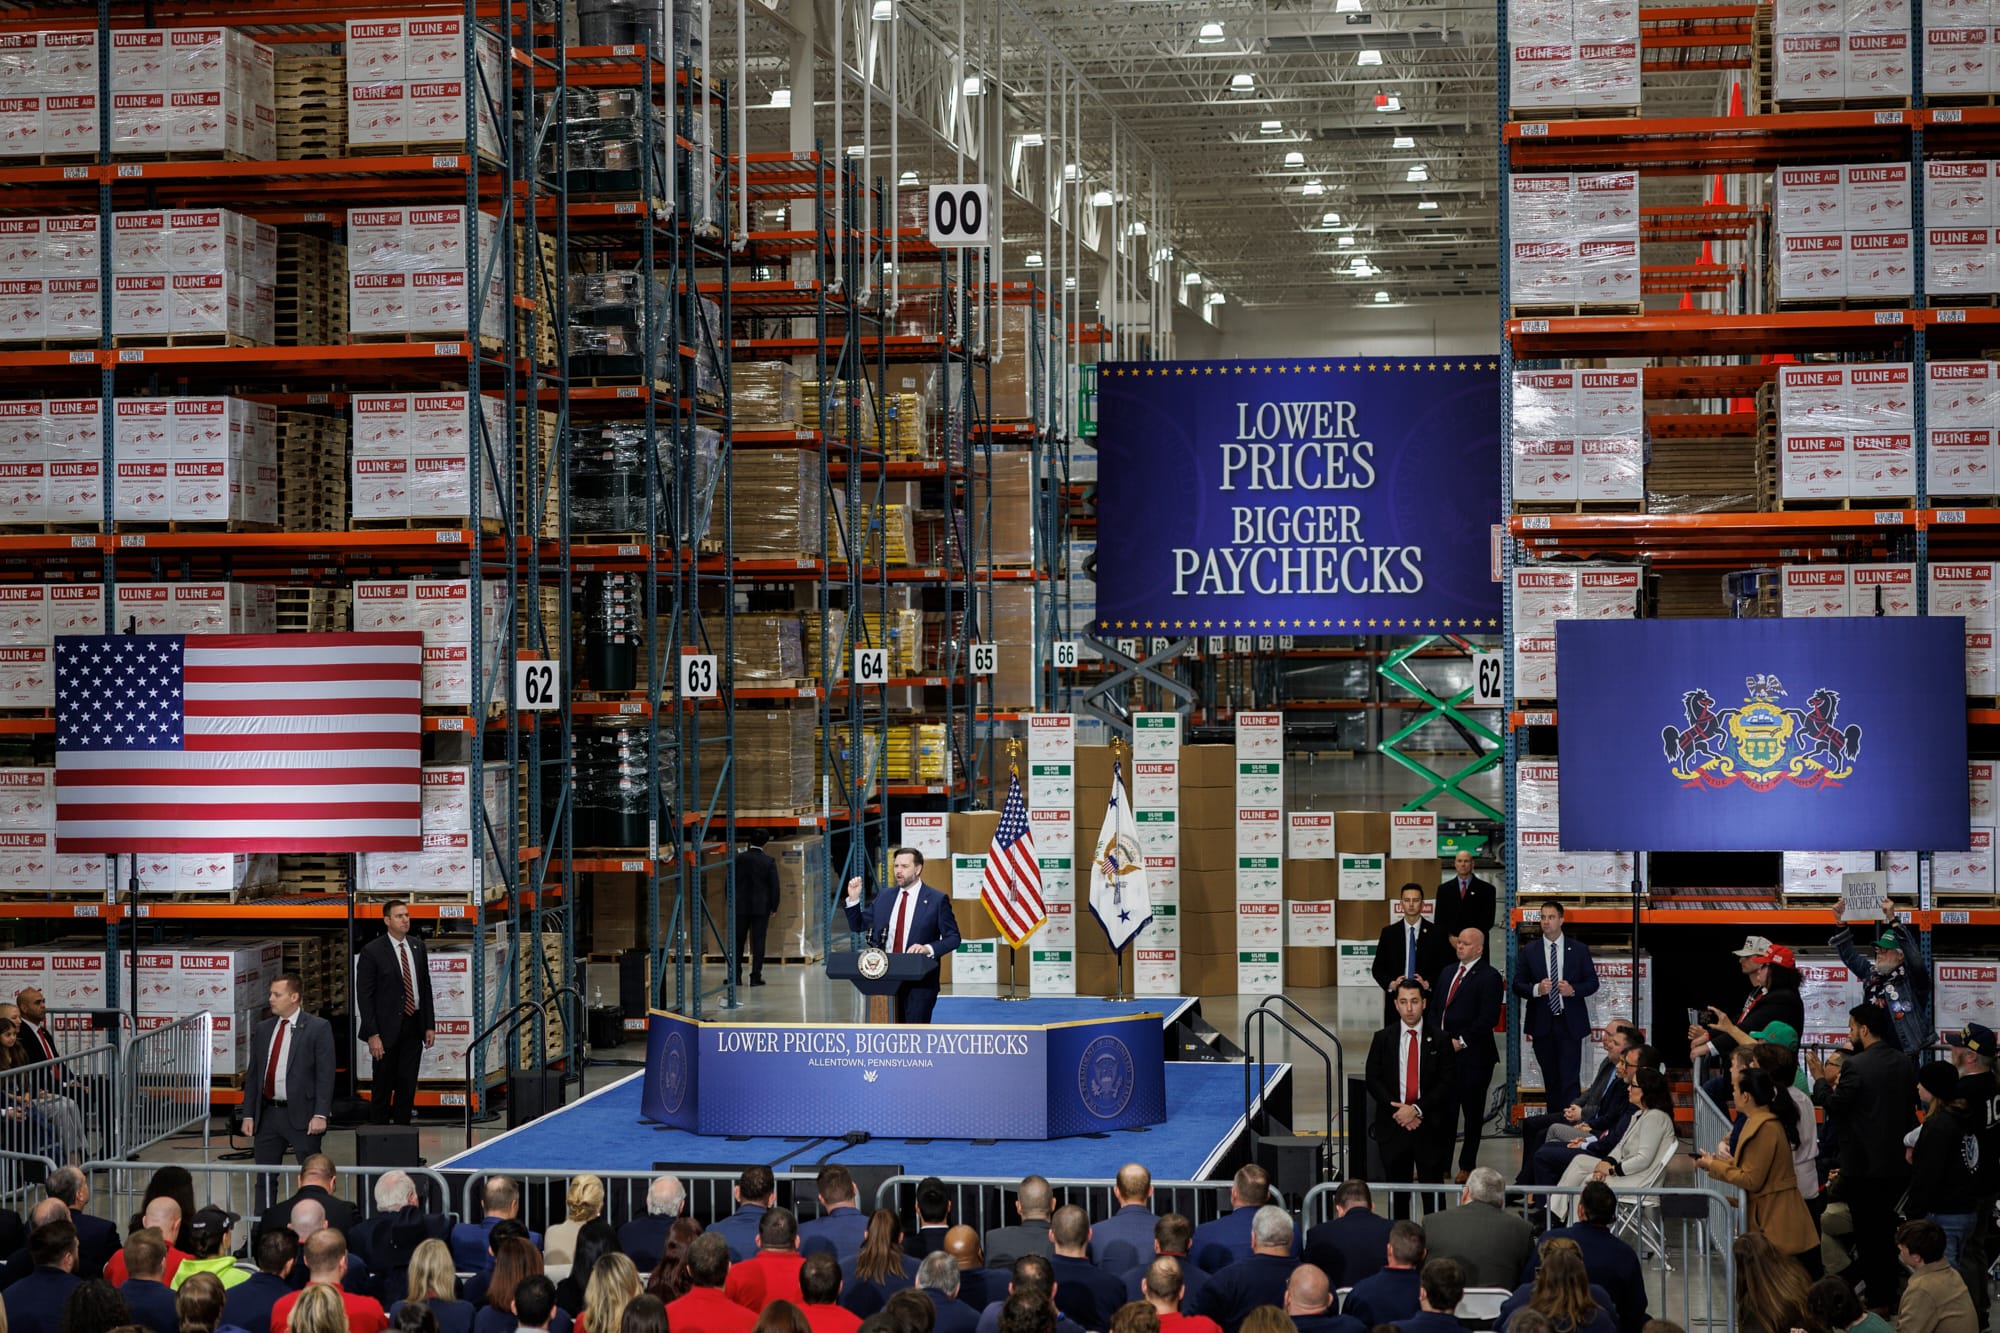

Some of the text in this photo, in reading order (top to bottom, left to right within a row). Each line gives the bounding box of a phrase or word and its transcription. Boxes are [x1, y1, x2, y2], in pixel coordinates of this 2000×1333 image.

[411, 24, 443, 33] ULINE
[116, 36, 147, 45] ULINE
[1931, 32, 1967, 42] ULINE
[1785, 39, 1821, 50] ULINE
[1852, 38, 1887, 48] ULINE
[413, 86, 445, 95] ULINE
[117, 97, 147, 106] ULINE
[174, 94, 204, 104] ULINE
[1852, 170, 1887, 180] ULINE
[1931, 166, 1967, 176] ULINE
[1785, 173, 1821, 183] ULINE
[412, 213, 444, 222] ULINE
[935, 190, 982, 235] 00
[118, 218, 148, 227] ULINE
[1854, 237, 1889, 247] ULINE
[1932, 233, 1968, 243] ULINE
[1788, 239, 1824, 249] ULINE
[175, 277, 206, 286] ULINE
[415, 275, 447, 284] ULINE
[51, 282, 82, 291] ULINE
[1788, 374, 1824, 384] ULINE
[1854, 371, 1889, 382] ULINE
[177, 403, 208, 413] ULINE
[417, 400, 448, 409] ULINE
[1236, 401, 1360, 440] LOWER
[1935, 433, 1970, 444] ULINE
[1790, 439, 1826, 450] ULINE
[52, 465, 83, 474] ULINE
[120, 465, 151, 475] ULINE
[177, 465, 208, 474] ULINE
[1219, 441, 1376, 490] PRICES
[1231, 505, 1365, 544] BIGGER
[1172, 545, 1424, 595] PAYCHECKS
[1936, 568, 1972, 578] ULINE
[1790, 573, 1826, 583] ULINE
[53, 589, 84, 598] ULINE
[121, 590, 152, 599] ULINE
[178, 589, 208, 598] ULINE
[419, 588, 450, 597] ULINE
[1212, 638, 1222, 652] 70
[1239, 637, 1249, 651] 71
[1262, 636, 1272, 649] 72
[1282, 635, 1291, 648] 73
[1121, 641, 1133, 657] 67
[975, 648, 993, 670] 65
[1058, 645, 1074, 664] 66
[861, 652, 883, 678] 64
[688, 660, 711, 692] 63
[1480, 658, 1501, 698] 62
[525, 666, 553, 704] 62
[422, 773, 448, 784] LINE
[1525, 769, 1558, 779] ULINE
[1525, 834, 1559, 844] ULINE
[1849, 883, 1877, 897] BIGGER
[1242, 905, 1267, 913] ULINE
[54, 958, 85, 968] ULINE
[183, 957, 214, 967] ULINE
[1942, 969, 1978, 979] ULINE
[717, 1032, 1029, 1056] LOWER PRICES, BIGGER PAYCHECKS
[808, 1058, 934, 1068] ALLENTOWN, PENNSYLVANIA
